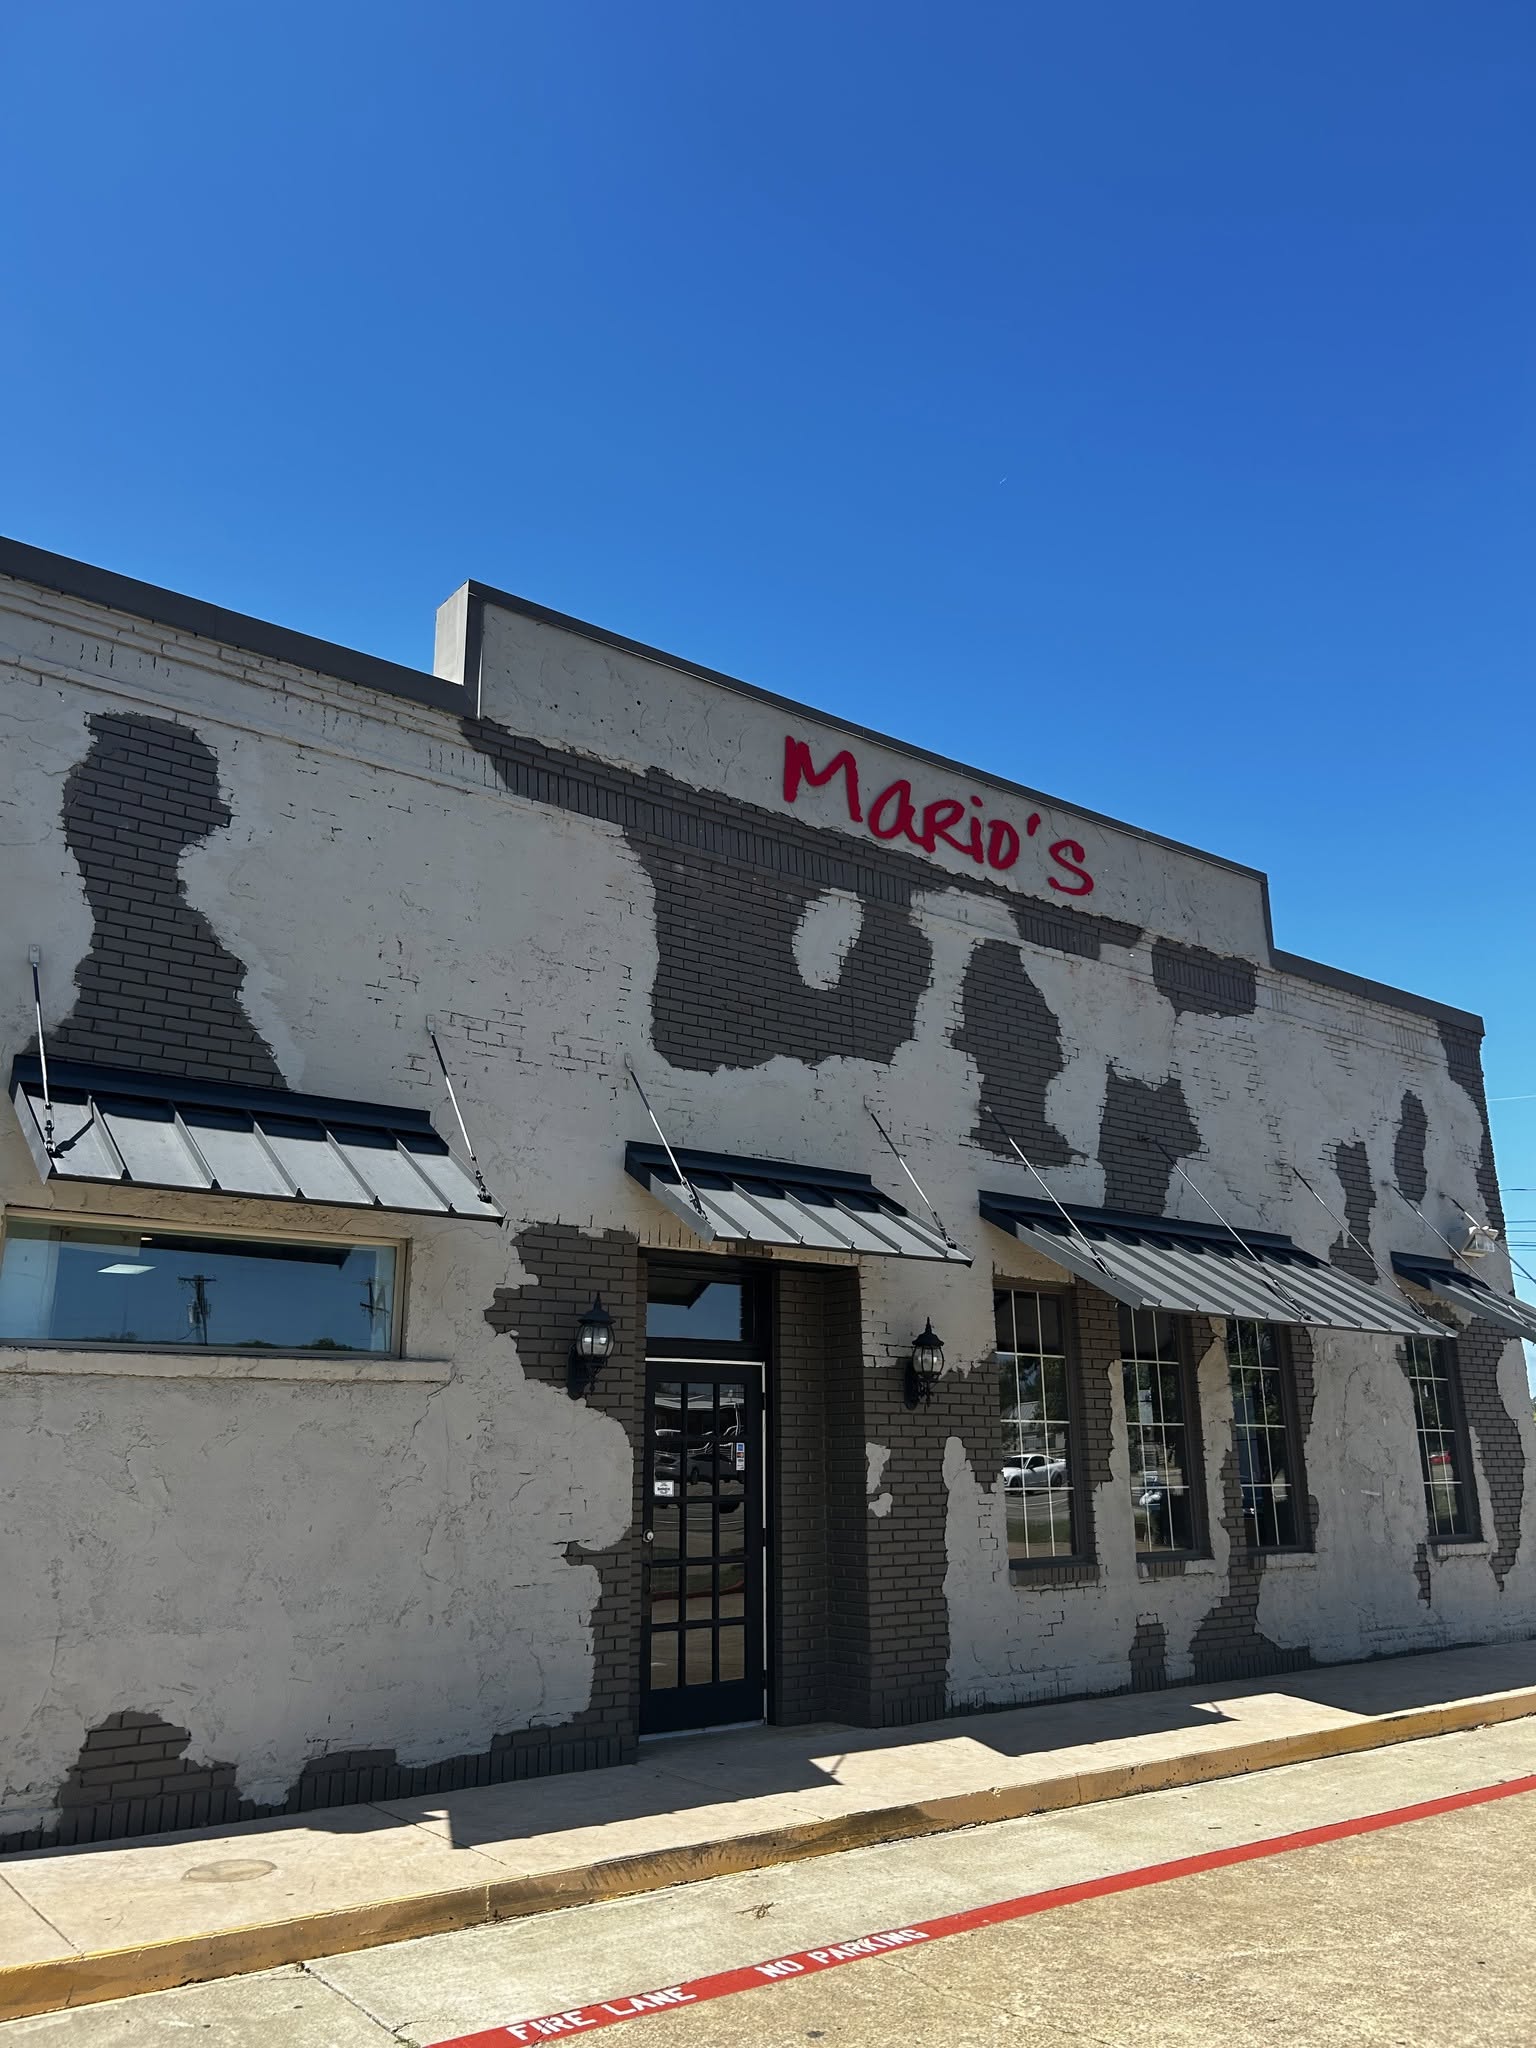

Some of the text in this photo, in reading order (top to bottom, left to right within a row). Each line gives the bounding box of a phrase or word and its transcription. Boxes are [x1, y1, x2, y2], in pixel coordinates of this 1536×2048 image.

[506, 1928, 930, 2041] FIRE LANE NO PARKING
